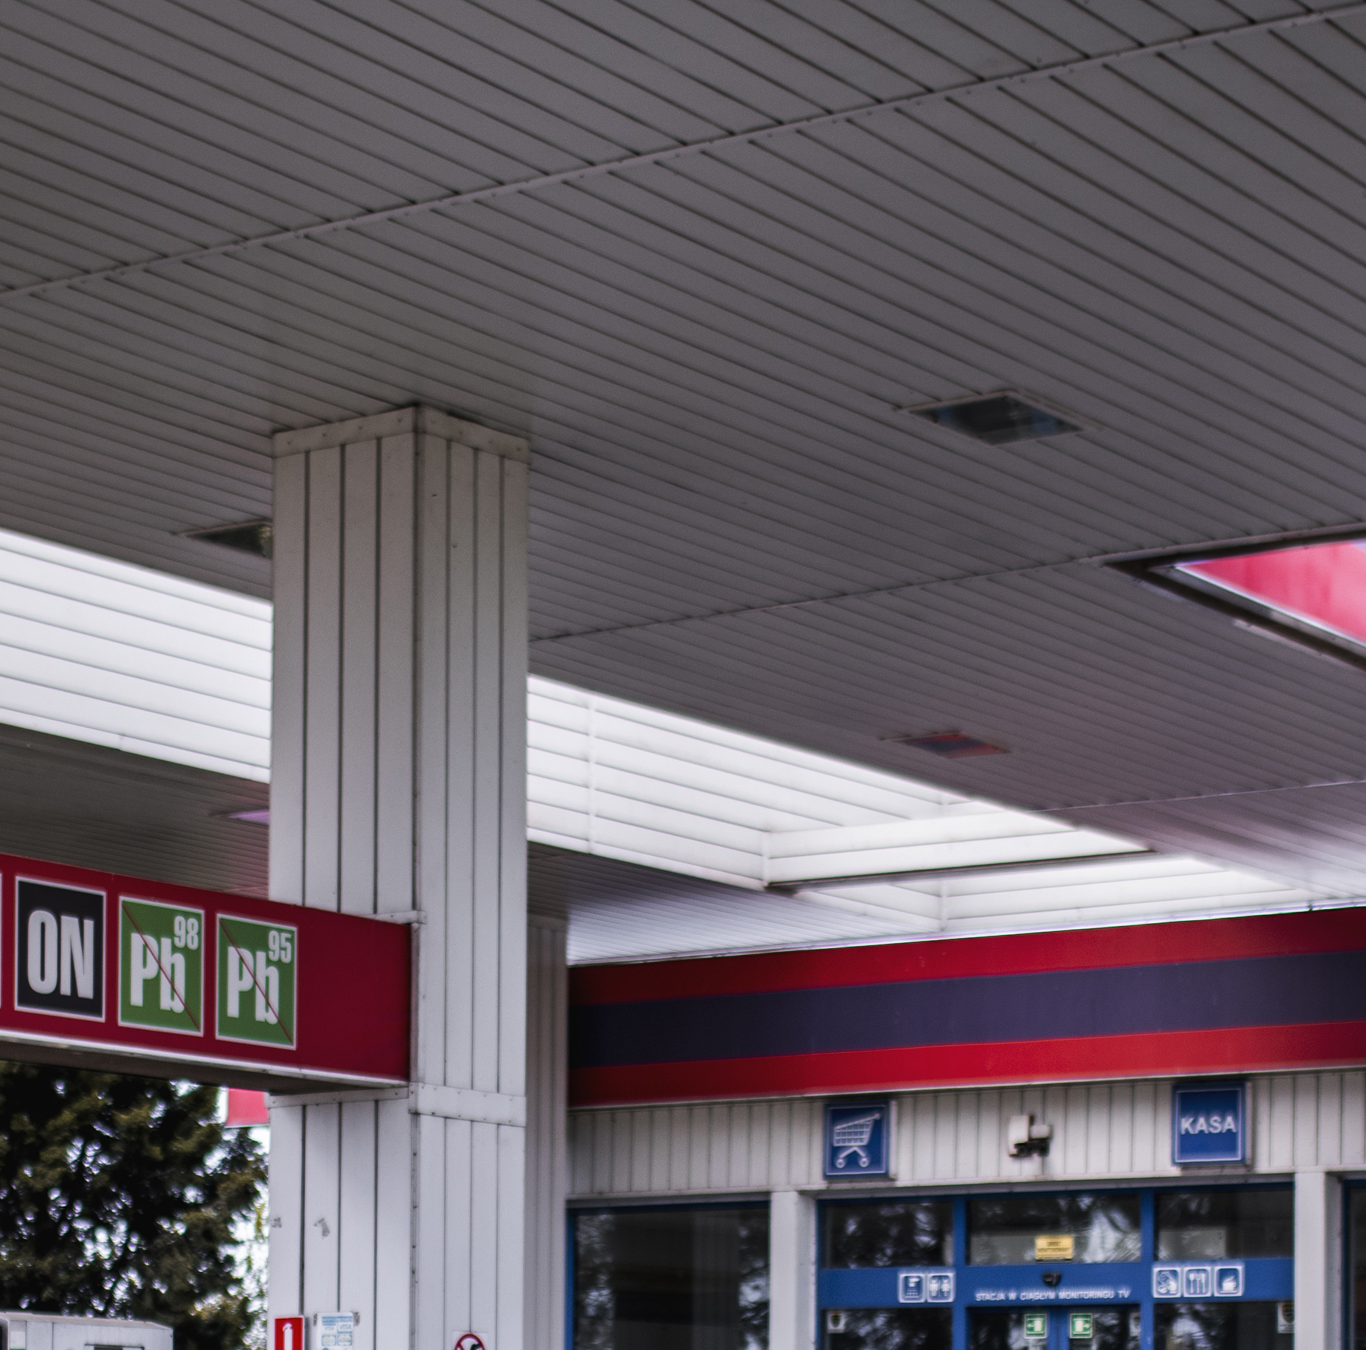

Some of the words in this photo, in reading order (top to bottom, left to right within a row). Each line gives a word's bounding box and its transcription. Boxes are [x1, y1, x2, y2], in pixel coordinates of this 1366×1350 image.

[27, 909, 95, 1000] ON
[129, 932, 186, 1014] Pb
[173, 914, 200, 951] 98
[227, 945, 280, 1026] Pb
[267, 930, 292, 965] 95
[1180, 1116, 1237, 1135] KASA
[1117, 1288, 1132, 1299] TV
